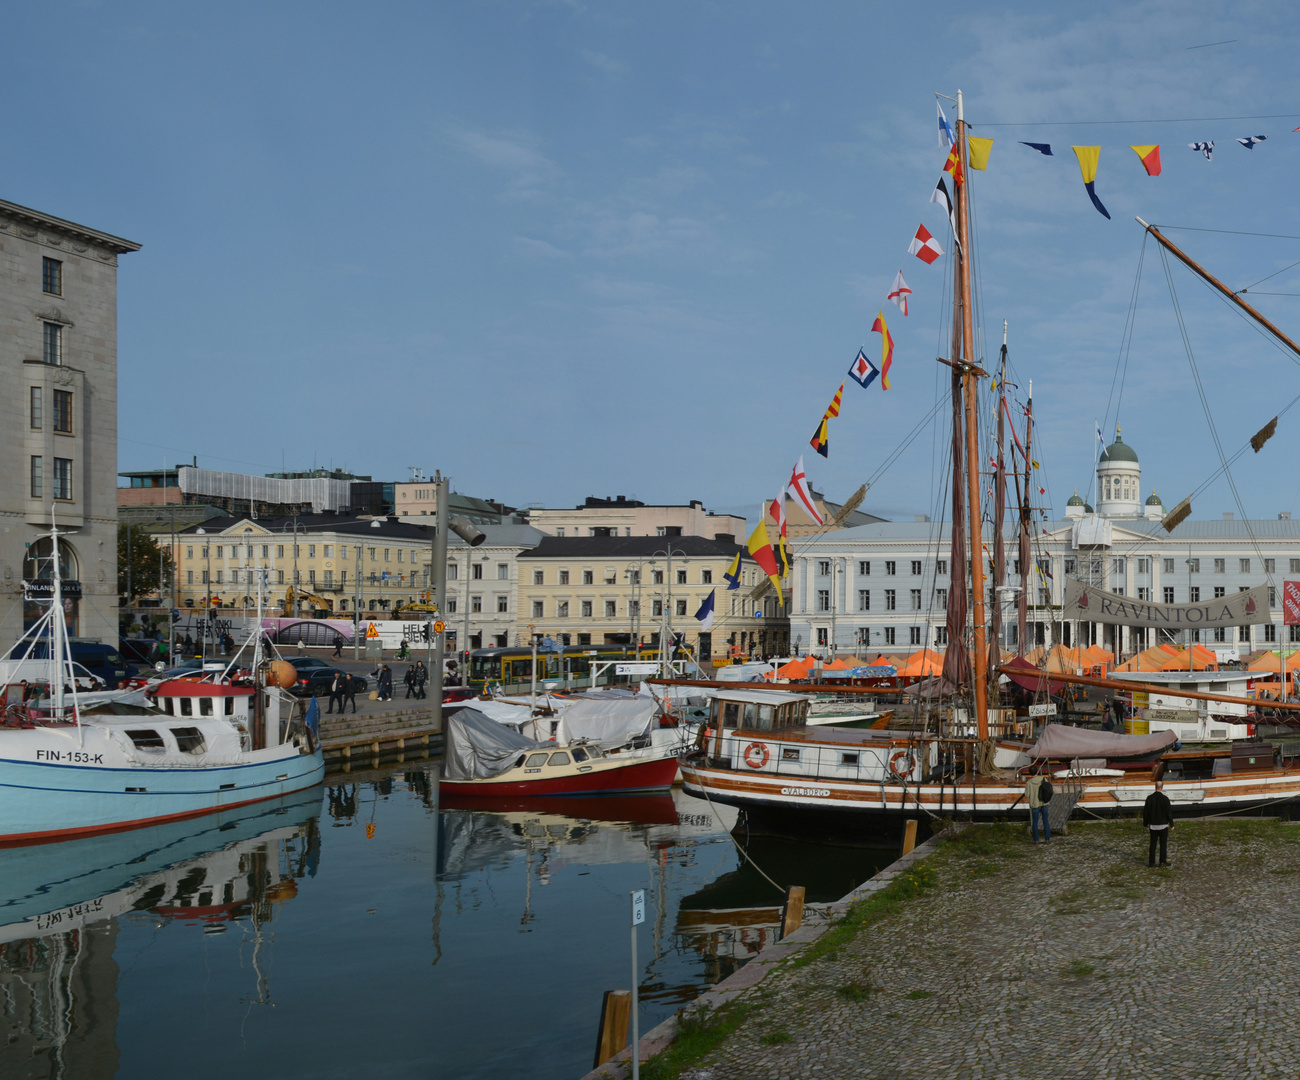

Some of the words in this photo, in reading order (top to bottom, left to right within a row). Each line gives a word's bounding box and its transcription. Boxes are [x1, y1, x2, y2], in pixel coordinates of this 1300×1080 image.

[1101, 597, 1234, 623] RAVINTOLA
[196, 619, 232, 629] HELINKI
[36, 749, 104, 764] FIN-153-K
[787, 788, 825, 796] VALBORG
[636, 910, 642, 920] 6
